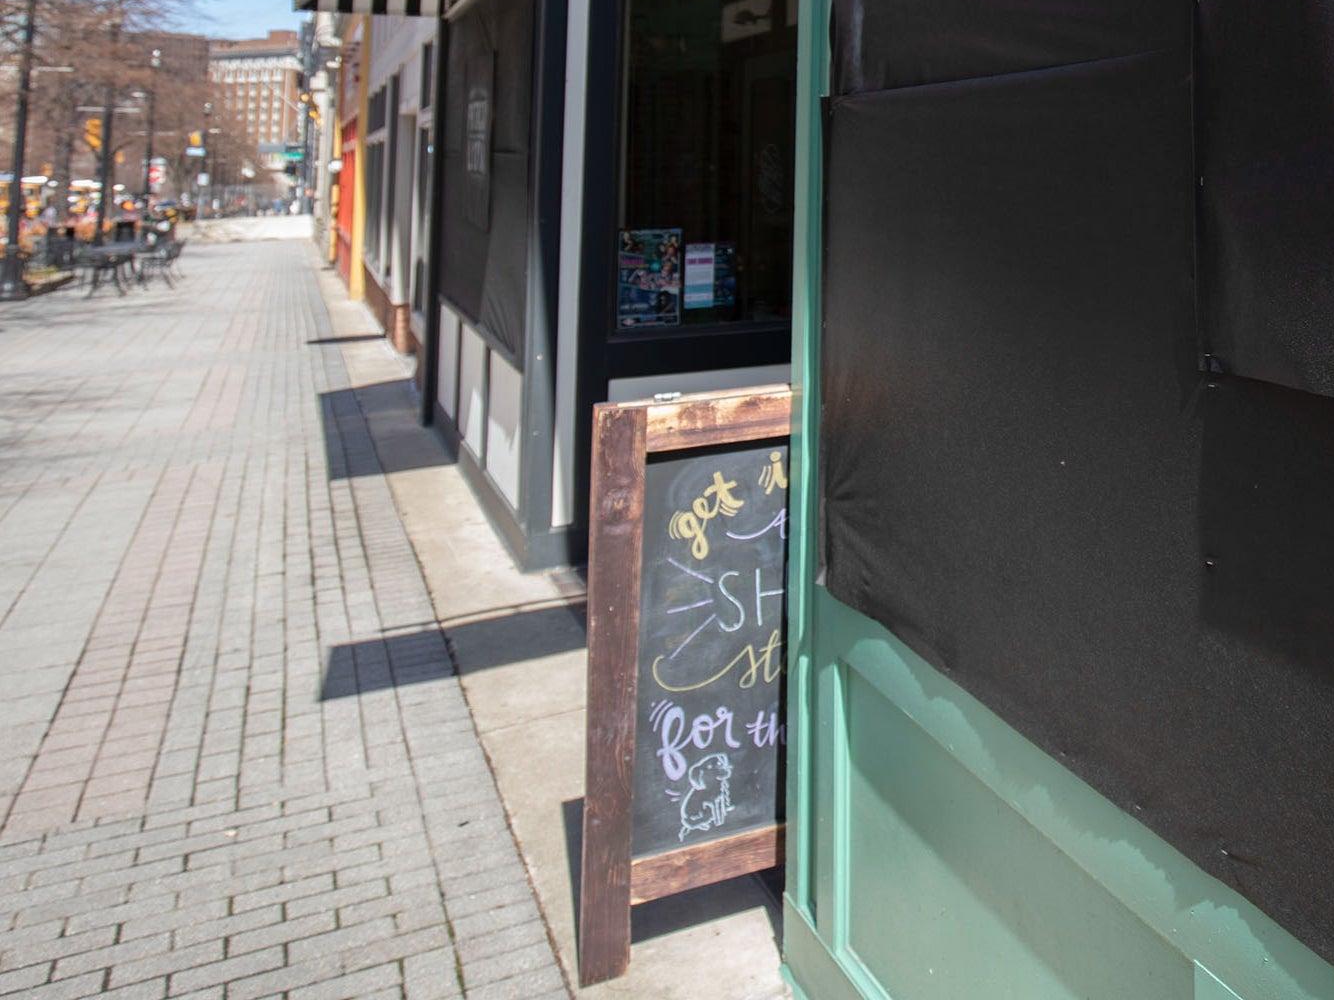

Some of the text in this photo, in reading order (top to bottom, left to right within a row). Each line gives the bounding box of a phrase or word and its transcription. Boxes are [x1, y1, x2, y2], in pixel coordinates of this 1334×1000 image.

[675, 471, 745, 560] get
[718, 568, 784, 632] SH
[657, 706, 785, 780] for th
